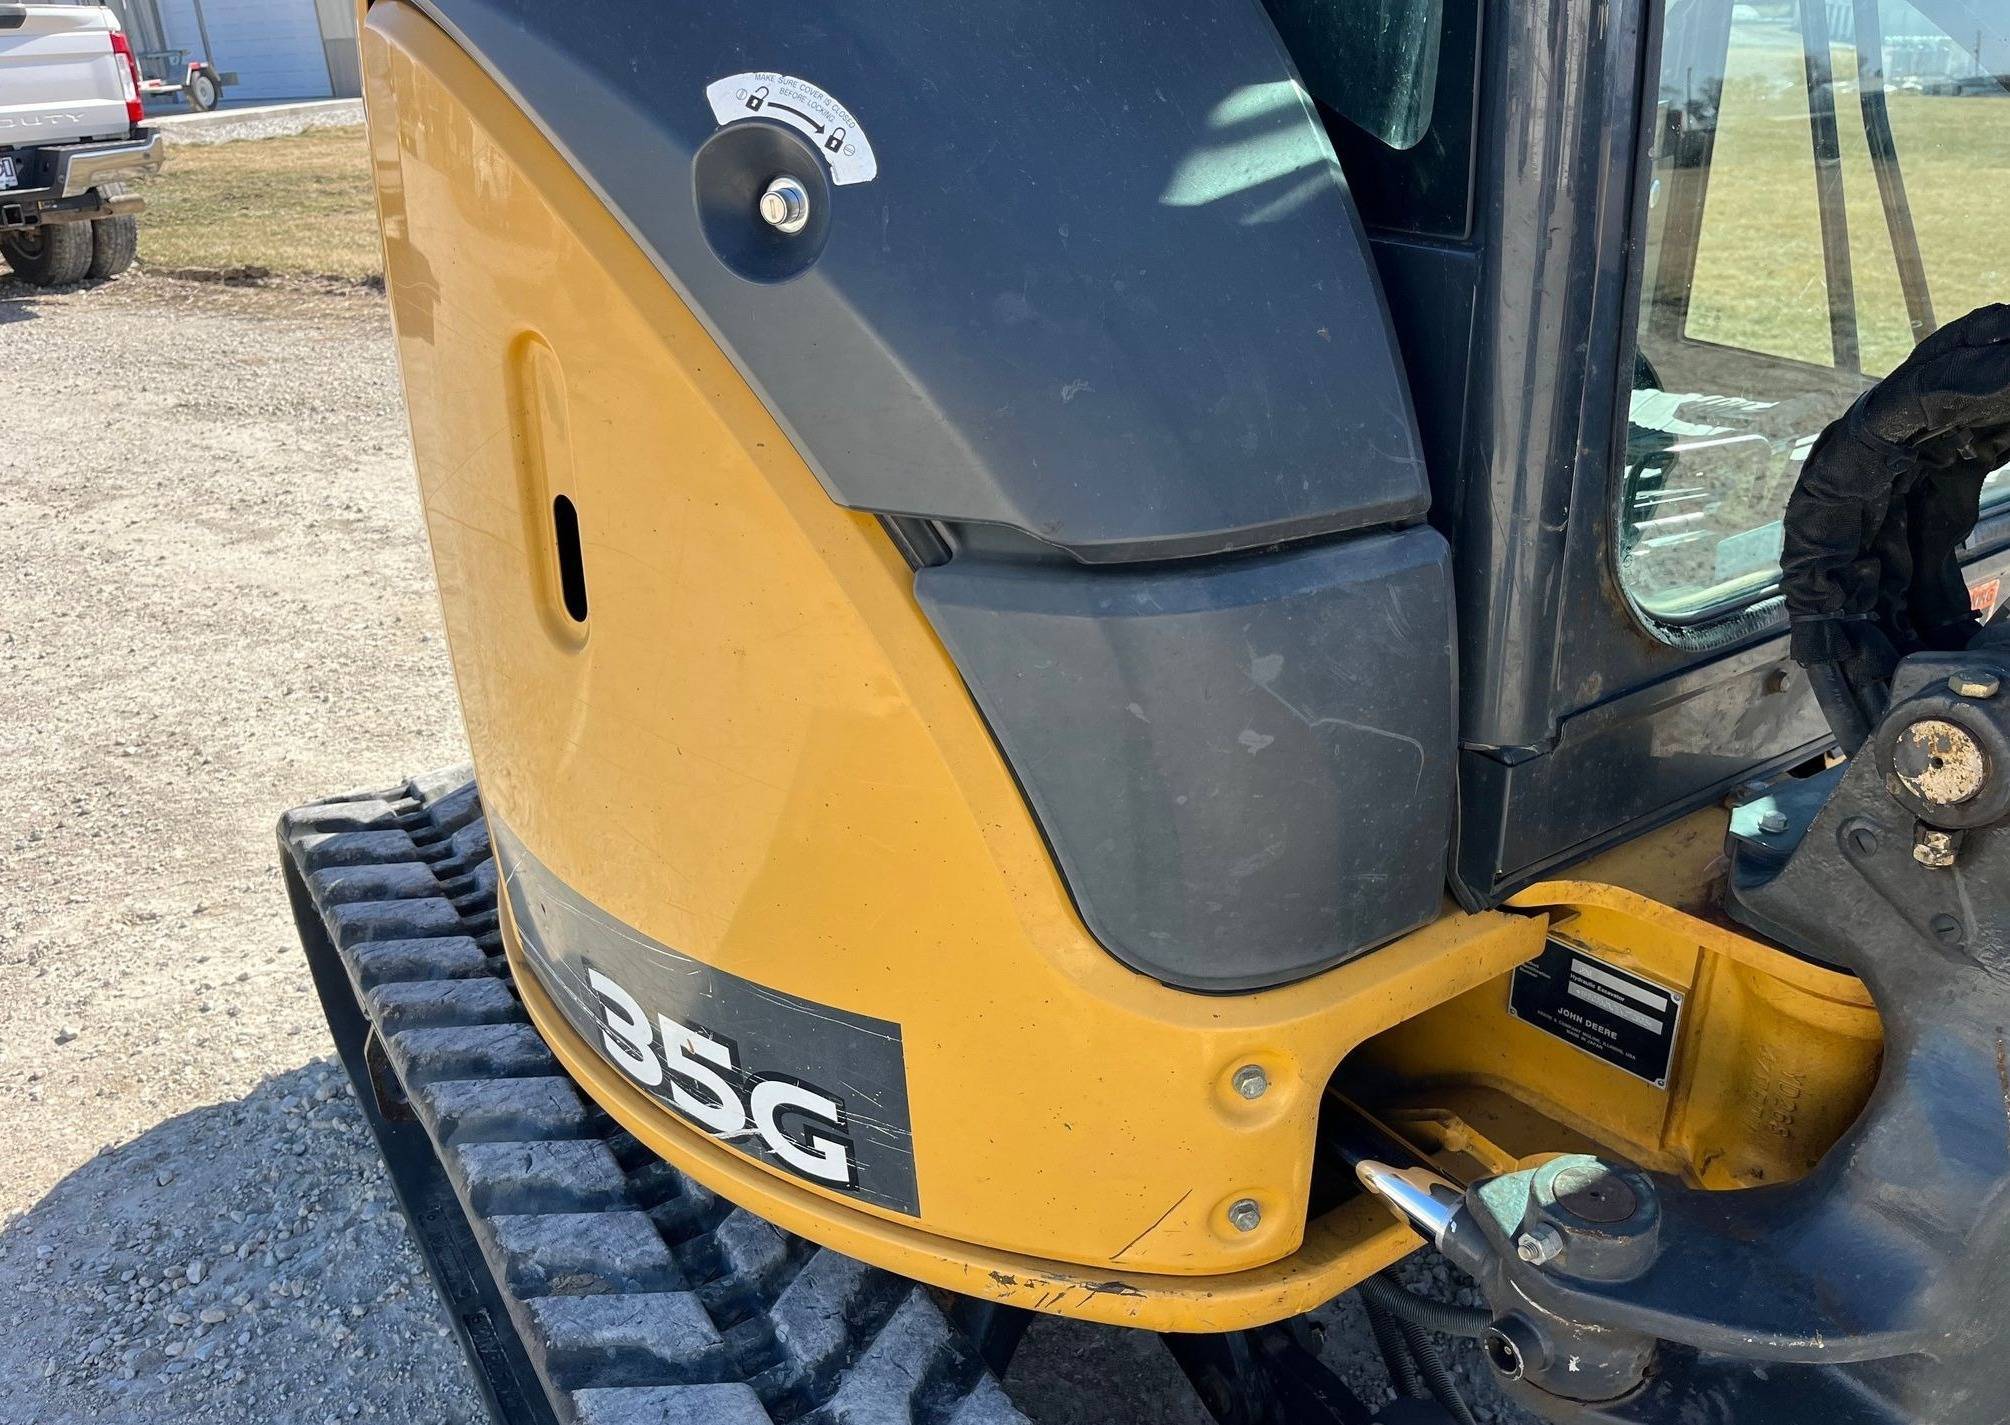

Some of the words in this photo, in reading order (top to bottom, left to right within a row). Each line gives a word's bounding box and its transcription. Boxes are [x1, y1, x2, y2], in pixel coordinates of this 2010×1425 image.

[755, 73, 775, 82] MAKE
[778, 76, 798, 88] SURE
[800, 83, 823, 100] COVER
[823, 95, 832, 106] IS
[831, 102, 855, 129] CLOSED
[779, 87, 807, 104] BEFORE
[806, 97, 836, 123] LOCKING
[1570, 973, 1595, 990] Hydraulic
[1597, 985, 1625, 1002] Excavator
[1557, 1006, 1582, 1024] JOHN
[1585, 1018, 1617, 1040] DEERE
[586, 966, 852, 1184] 35G
